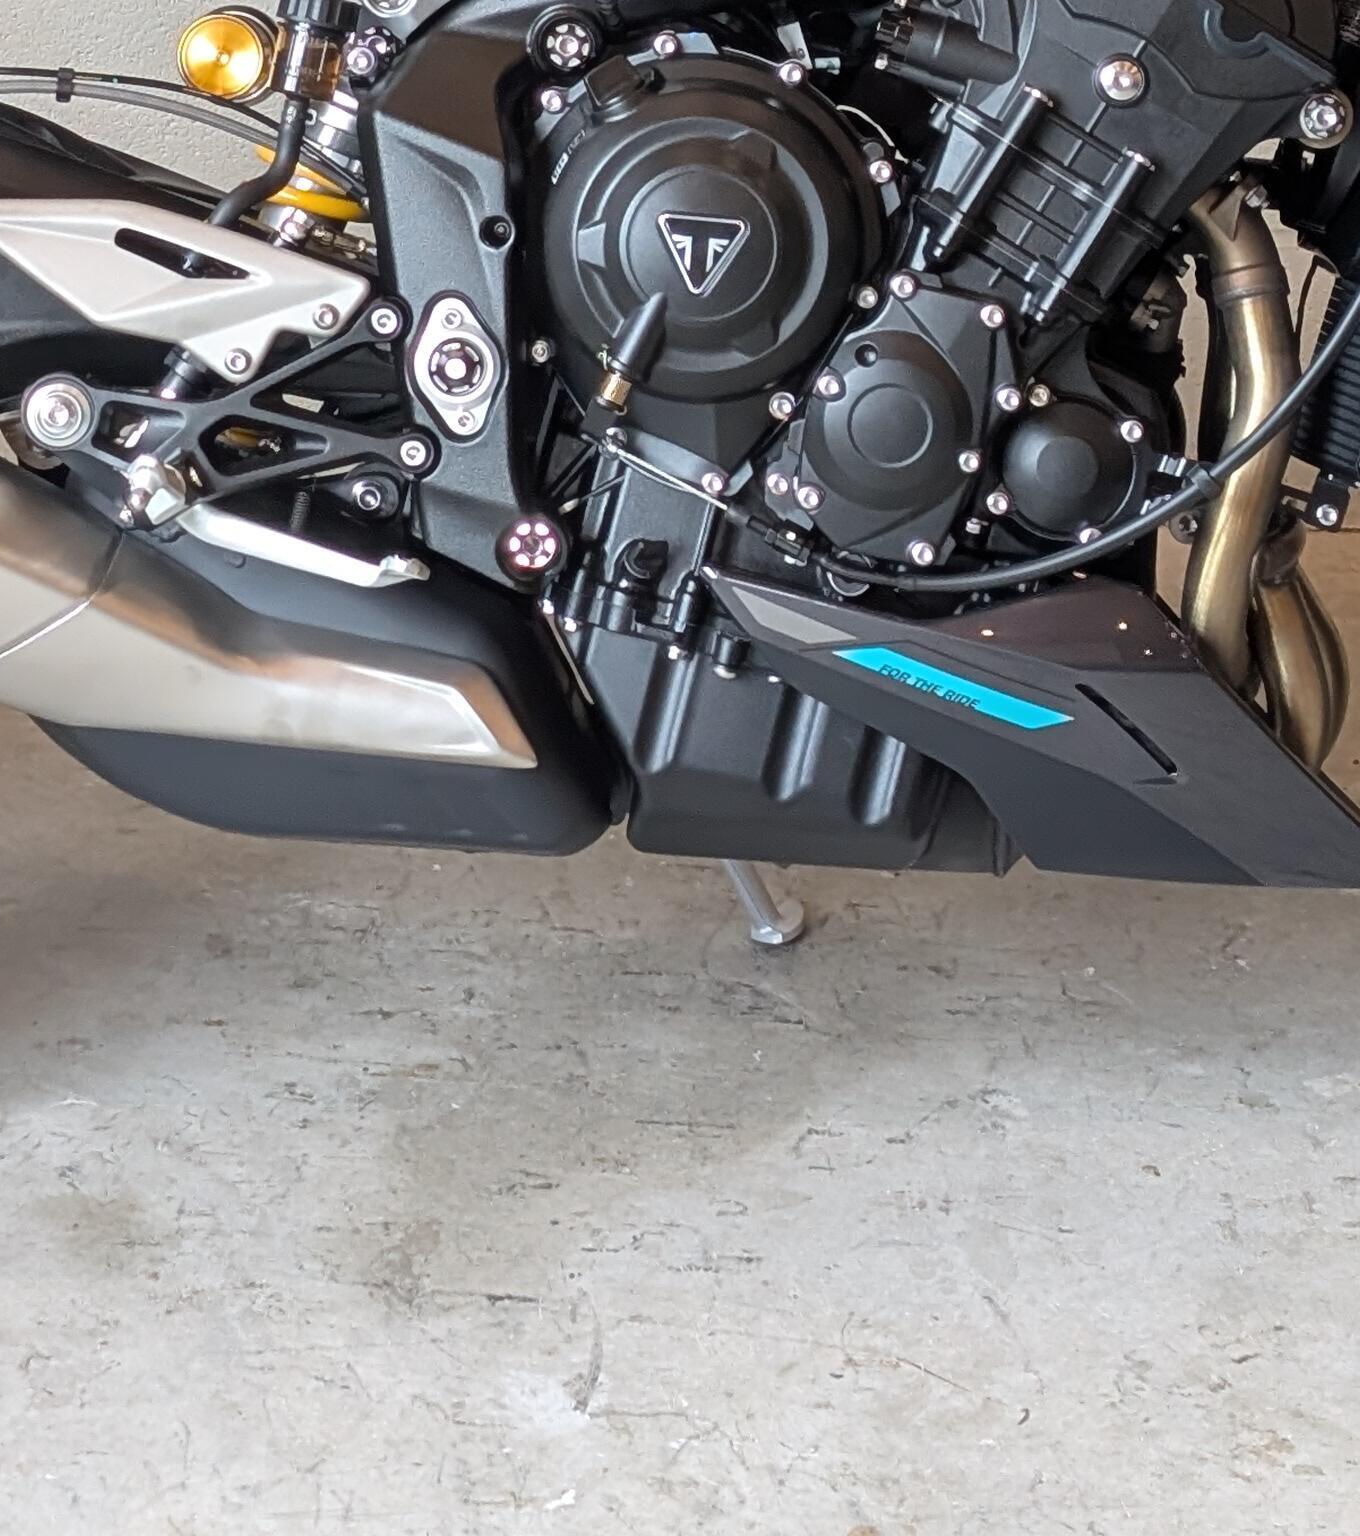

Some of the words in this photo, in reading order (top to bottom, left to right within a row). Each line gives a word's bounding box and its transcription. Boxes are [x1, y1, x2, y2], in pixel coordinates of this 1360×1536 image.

[879, 663, 912, 683] FOR
[913, 676, 944, 695] THE
[943, 689, 981, 710] RIDE
